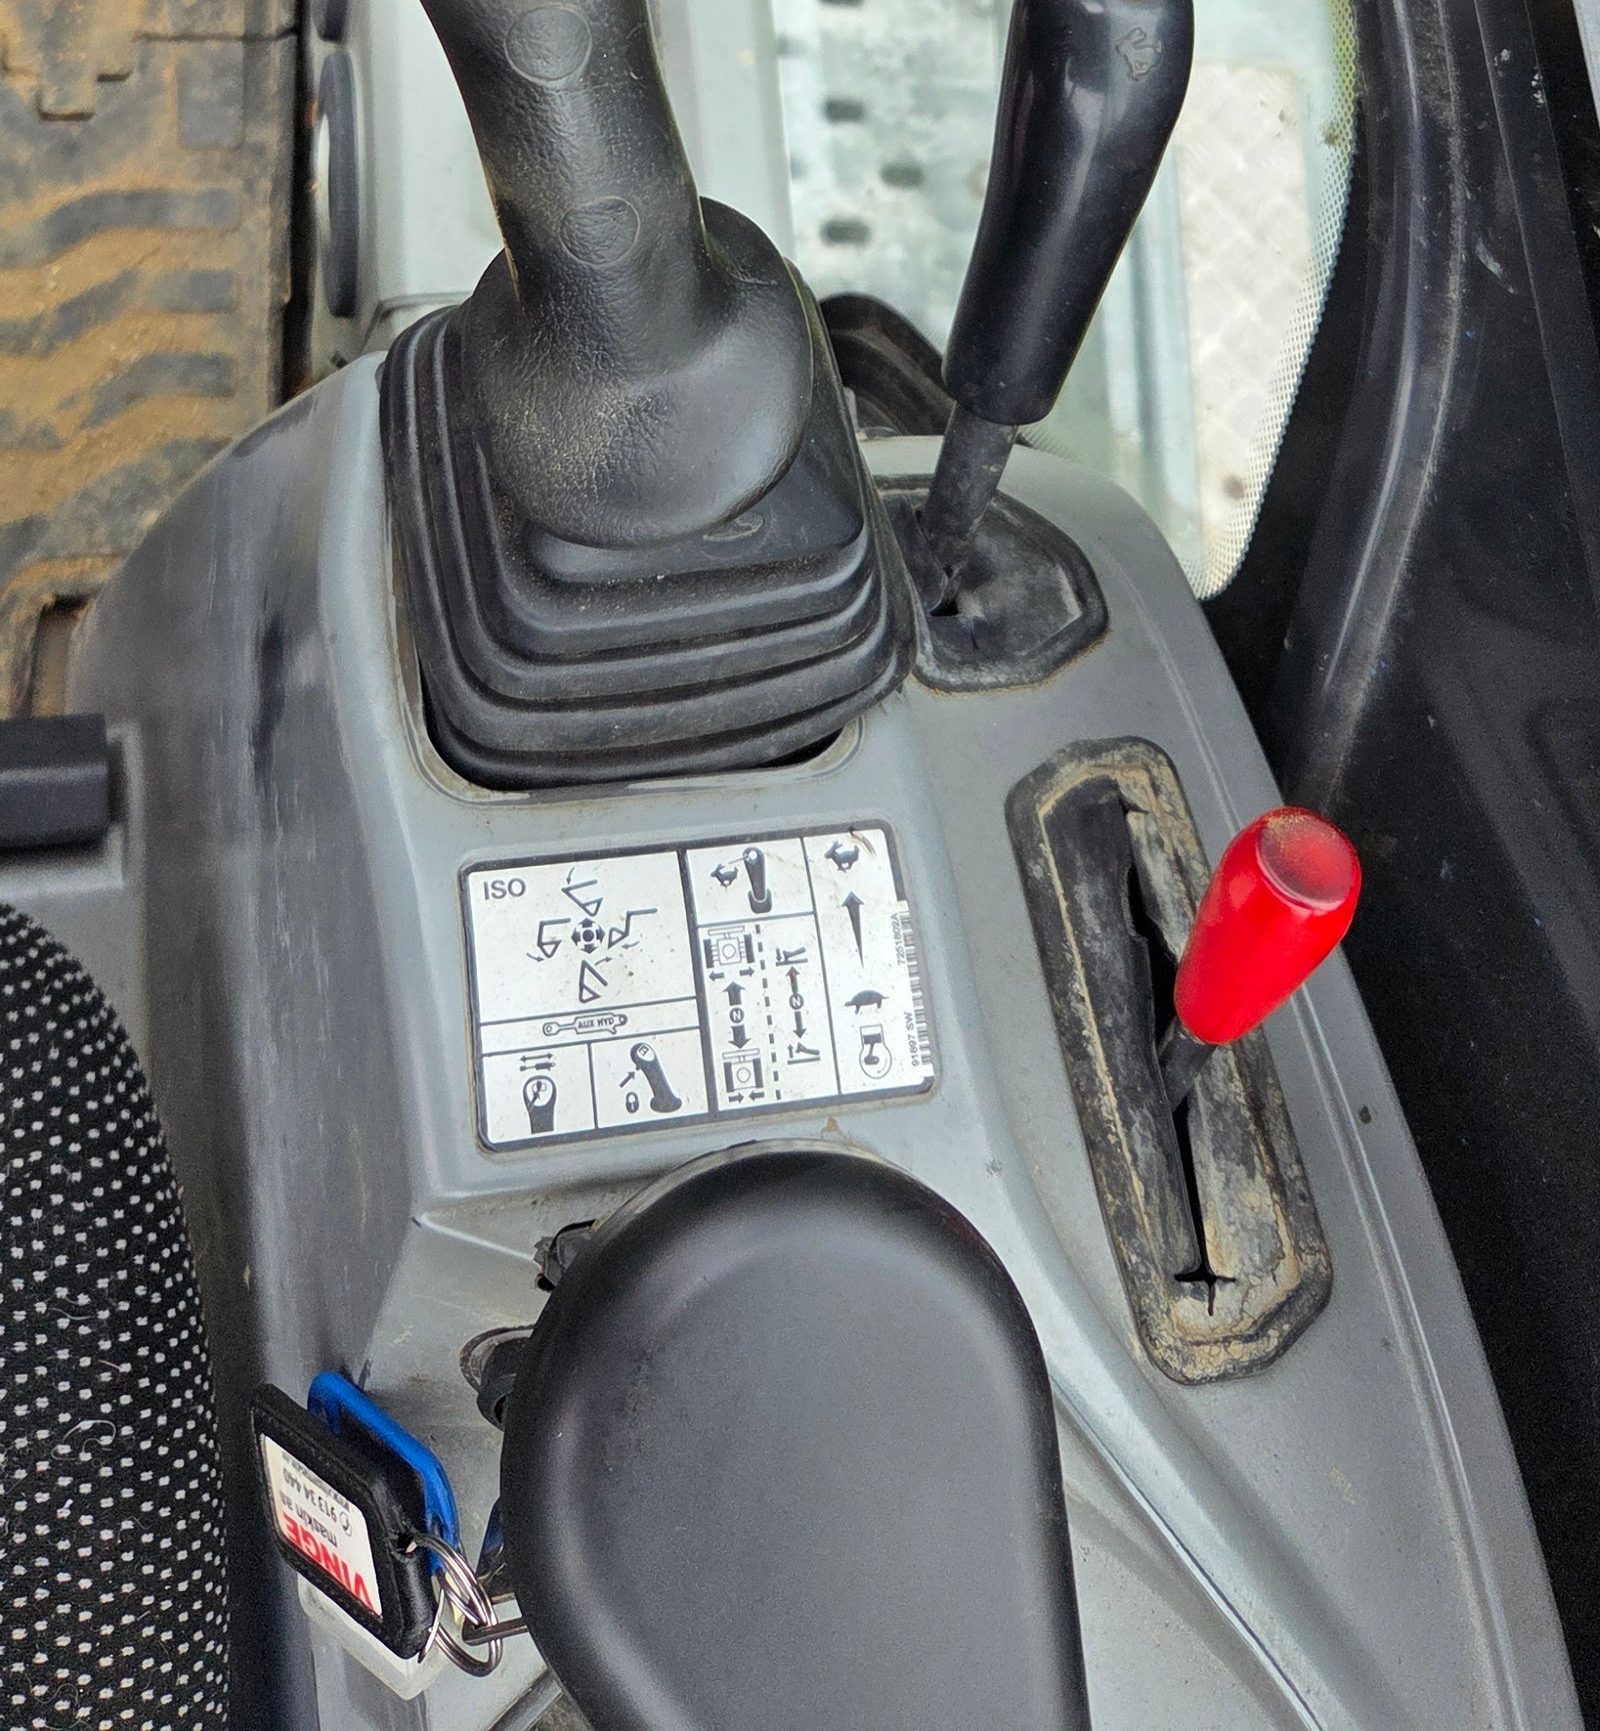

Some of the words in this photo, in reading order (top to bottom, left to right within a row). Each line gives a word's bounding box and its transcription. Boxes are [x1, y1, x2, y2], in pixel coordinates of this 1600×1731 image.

[483, 877, 526, 900] ISO
[578, 1019, 595, 1029] AUX
[597, 1017, 614, 1027] HYD
[904, 1012, 915, 1031] SW
[908, 1034, 920, 1067] 91897
[319, 1496, 337, 1523] 913
[295, 1505, 338, 1548] maskin
[282, 1511, 374, 1610] VINGE
